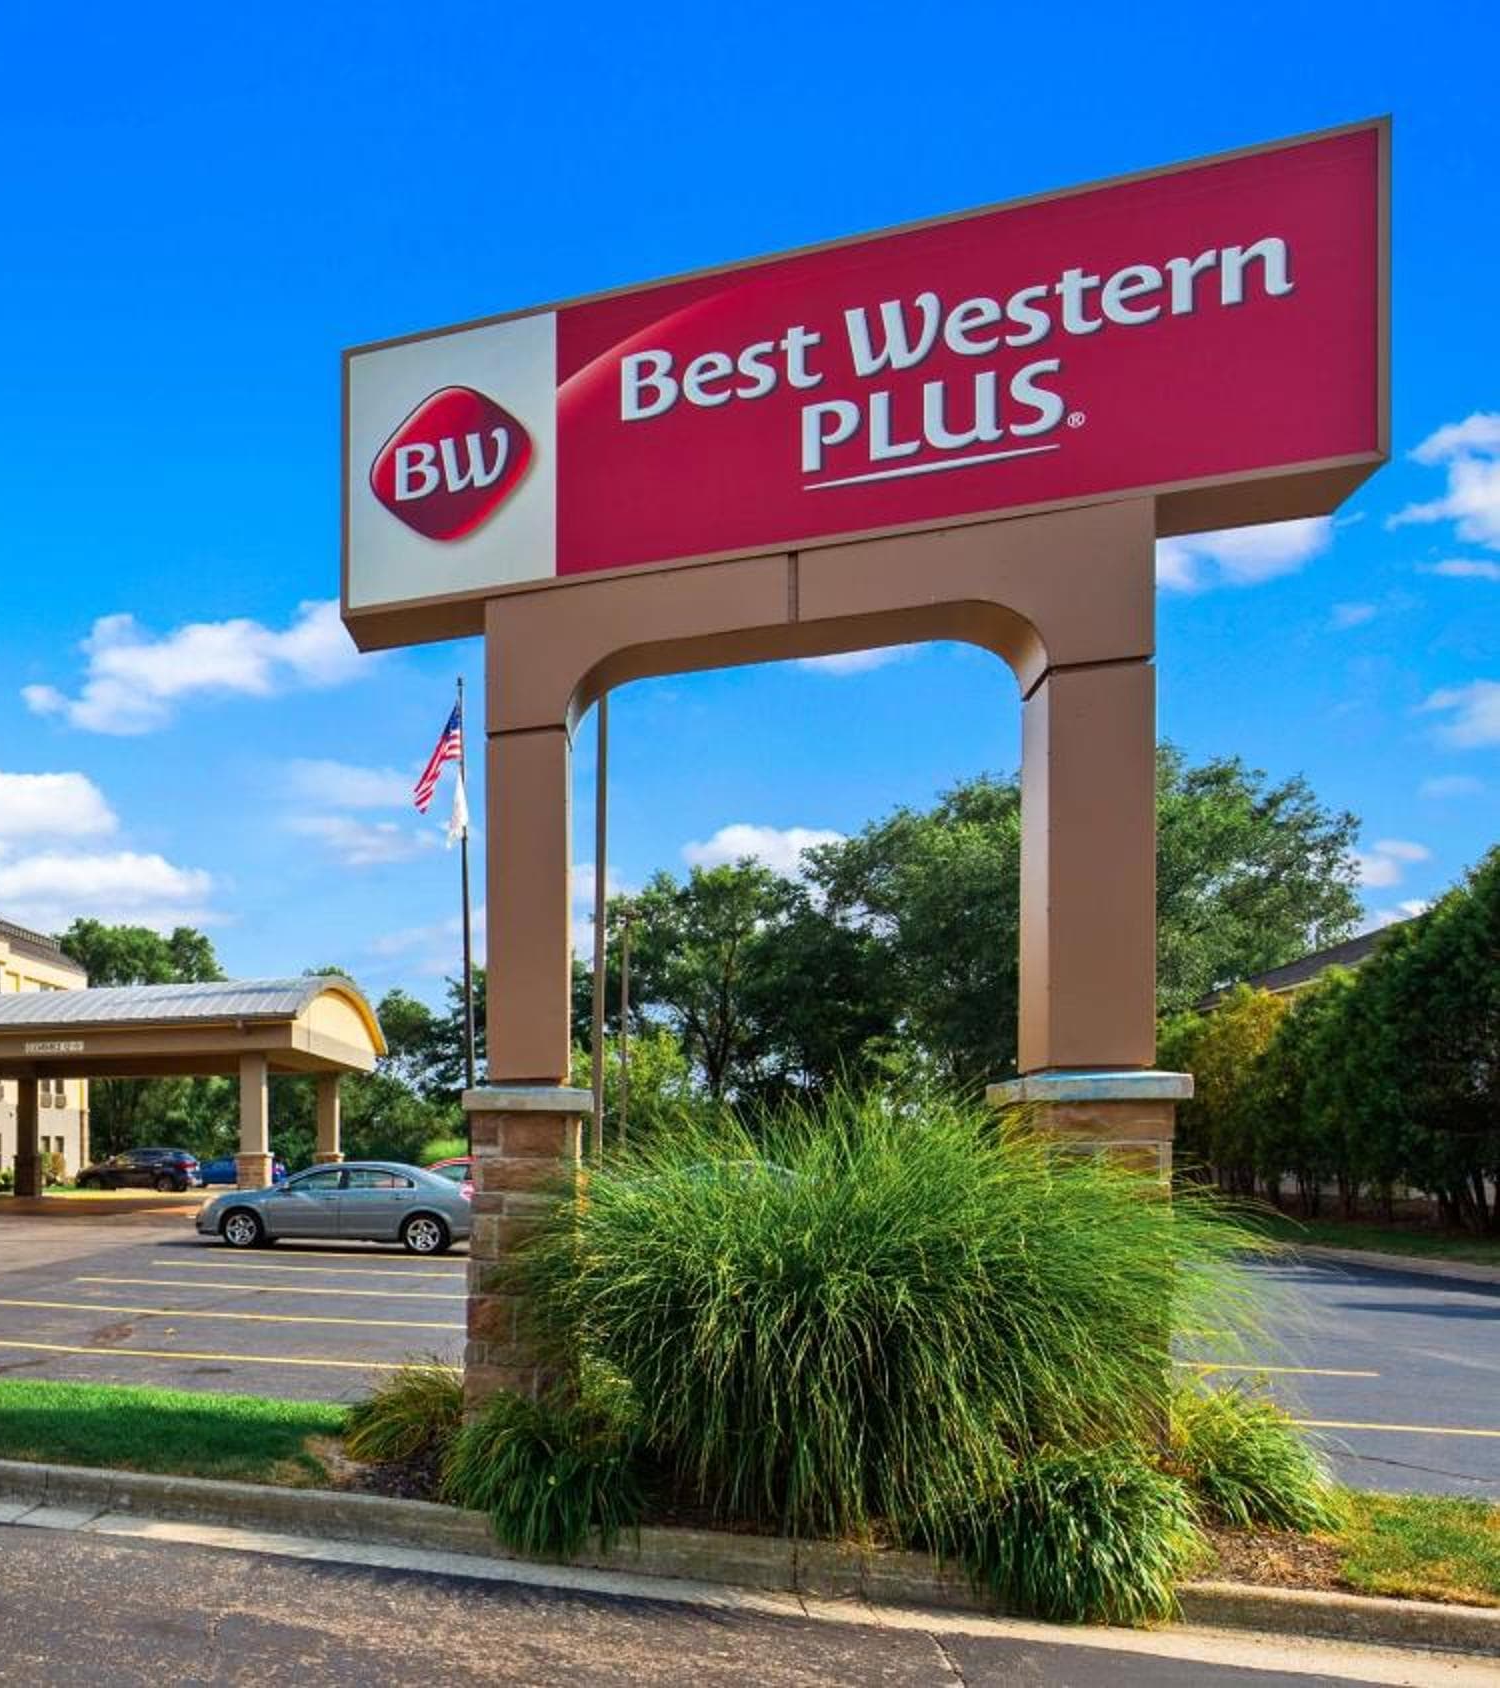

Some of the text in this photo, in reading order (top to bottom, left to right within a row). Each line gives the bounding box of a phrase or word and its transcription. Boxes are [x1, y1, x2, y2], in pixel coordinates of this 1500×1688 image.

[620, 236, 1295, 422] Best Western
[394, 426, 510, 502] BW
